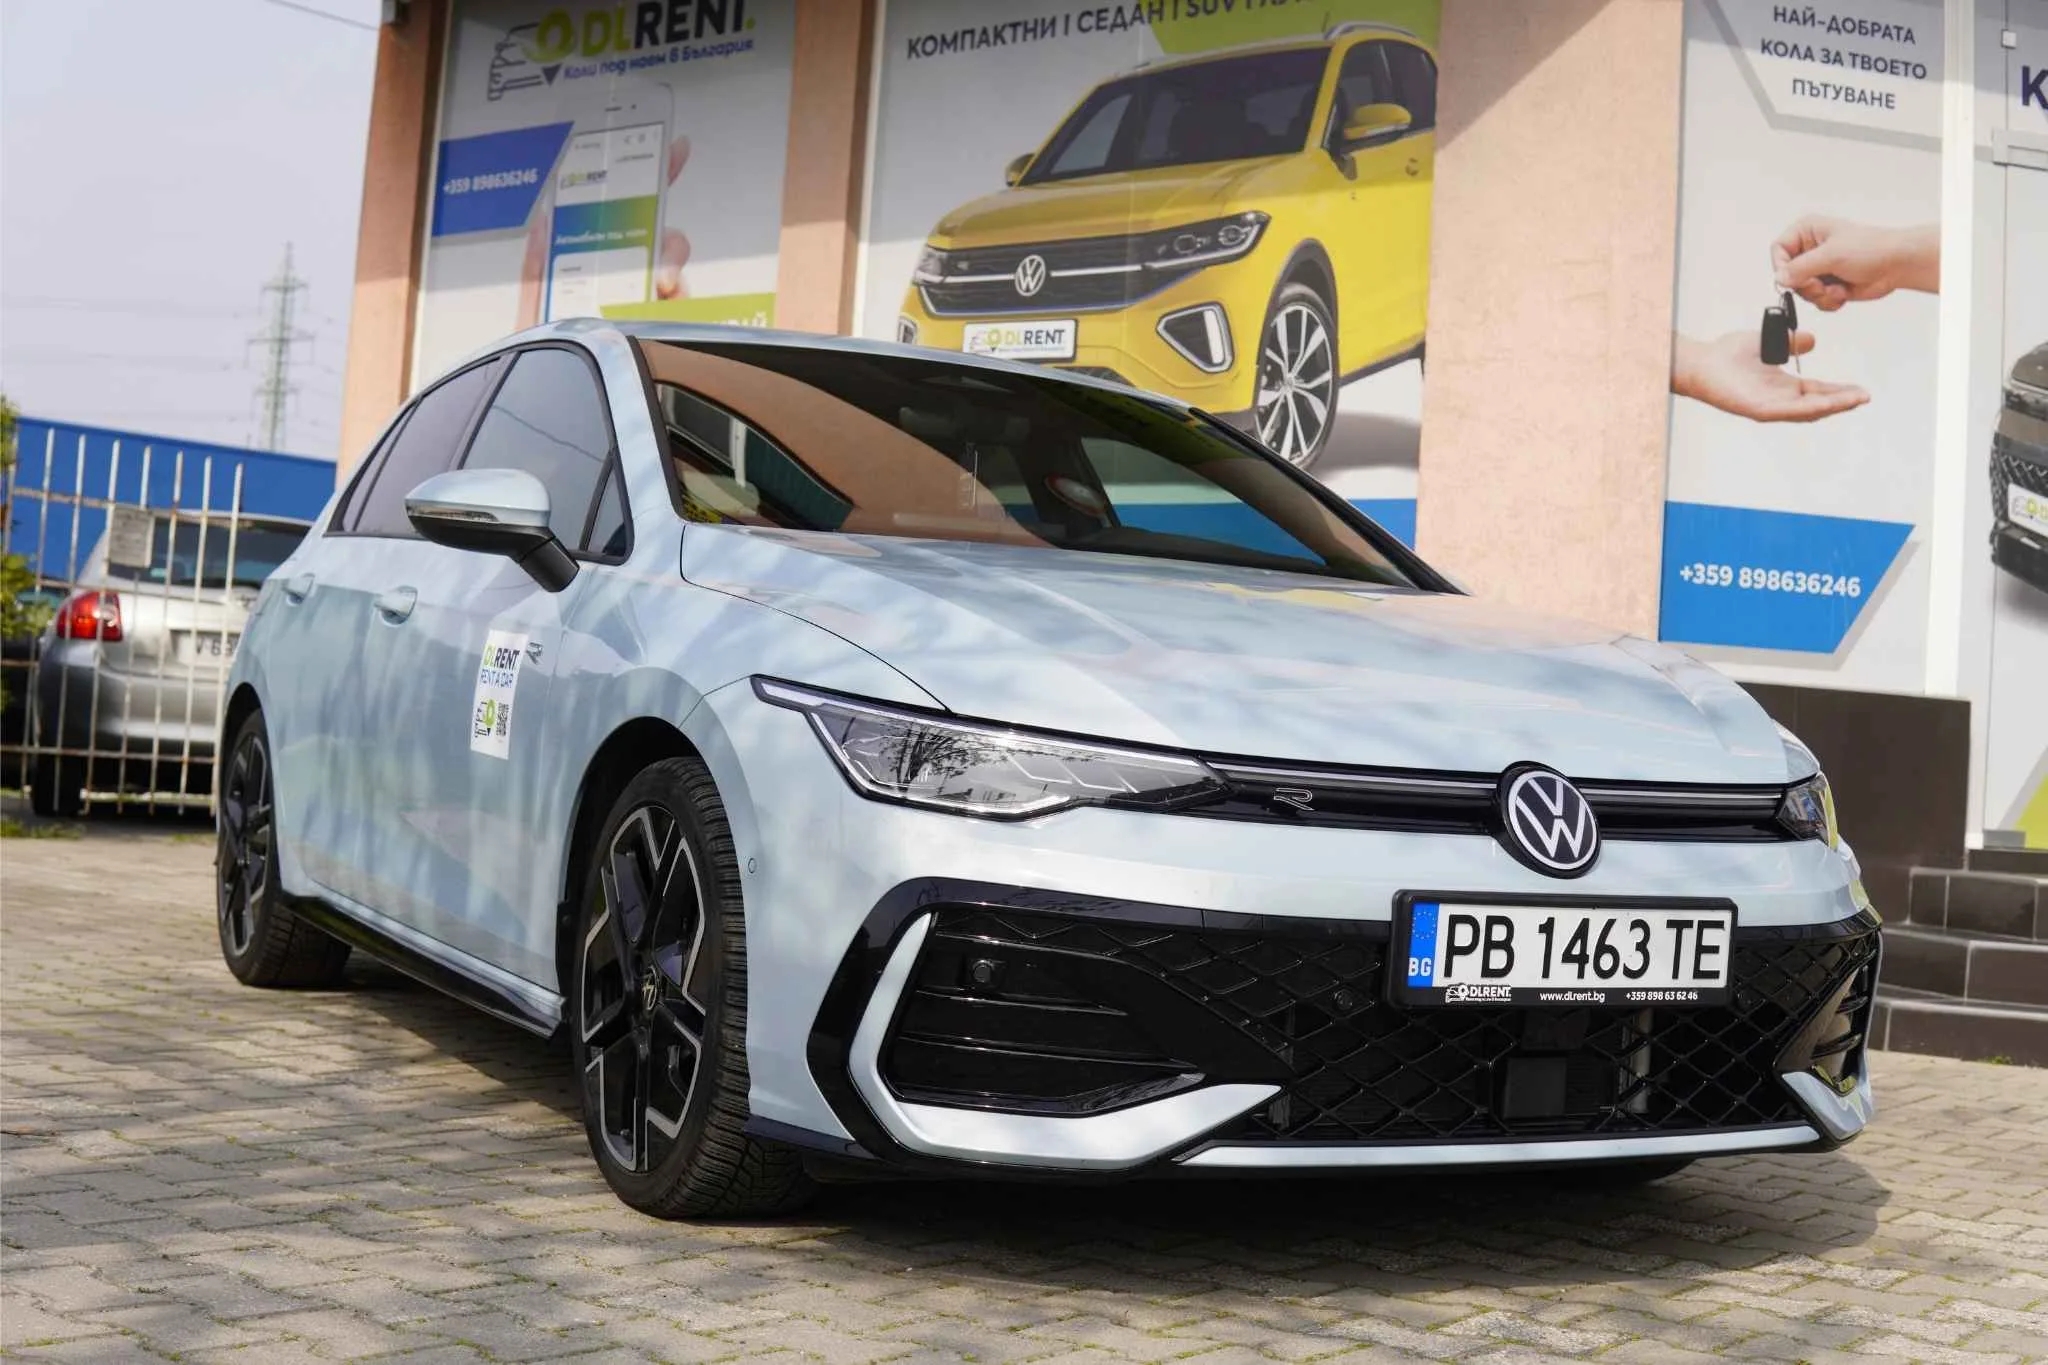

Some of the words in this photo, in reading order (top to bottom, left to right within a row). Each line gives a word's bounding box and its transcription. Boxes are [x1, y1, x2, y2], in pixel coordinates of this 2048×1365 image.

[907, 15, 1057, 60] КОМПАКТНИ
[1076, 0, 1165, 33] СЕДАН
[1773, 5, 1917, 45] НАЙ-ДОБРАТА
[682, 38, 754, 60] България
[1760, 38, 1815, 63] КОЛА
[1820, 47, 1845, 67] ЗА
[1848, 52, 1927, 79] ТВОЕТО
[1792, 78, 1896, 110] ПЪТУВАНЕ
[1680, 562, 1733, 587] +359
[1738, 567, 1861, 598] 898636246
[1444, 914, 1515, 979] PB
[1538, 917, 1651, 980] 1463
[1666, 919, 1726, 980] TE
[1408, 958, 1432, 976] BG
[1540, 991, 1606, 1003] www.dlrent.bg
[1626, 991, 1647, 1001] +359
[1647, 991, 1664, 1001] 898
[1665, 991, 1675, 1001] 63
[1676, 991, 1687, 1001] 62
[1687, 991, 1698, 1001] 46
